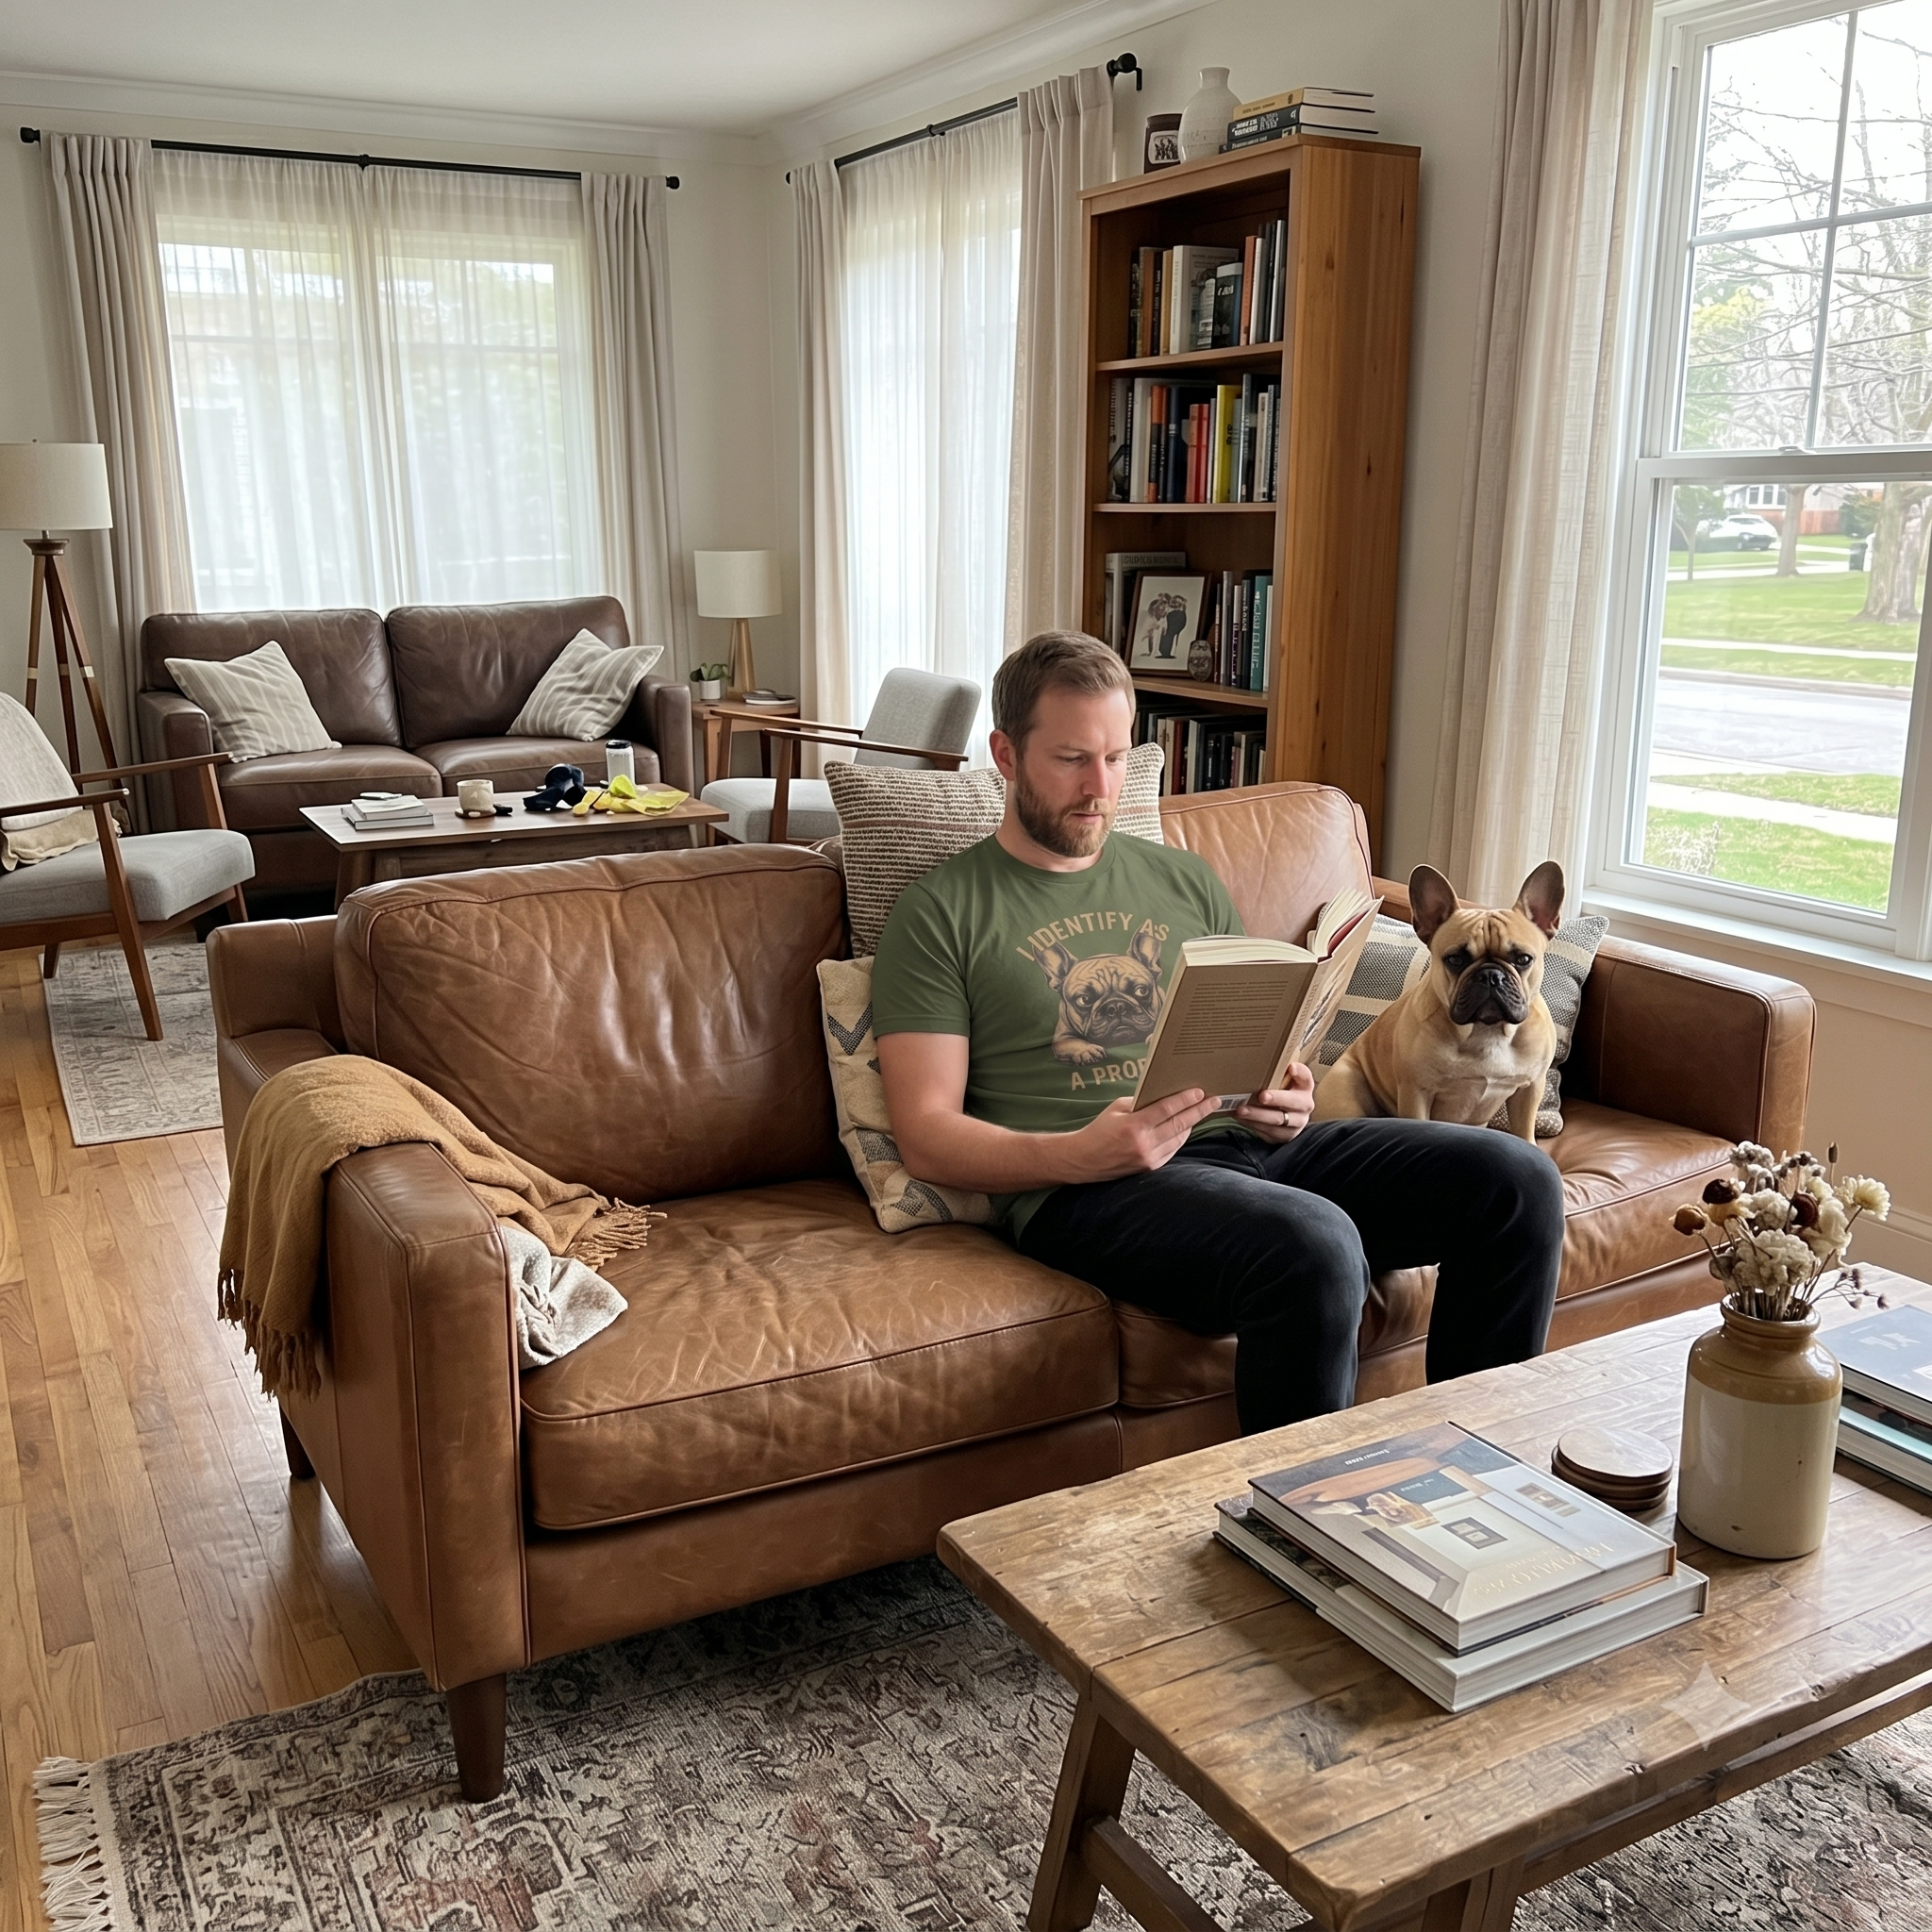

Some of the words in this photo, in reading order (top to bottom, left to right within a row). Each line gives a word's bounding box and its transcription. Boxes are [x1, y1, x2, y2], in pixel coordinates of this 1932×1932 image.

[1016, 946, 1035, 961] I
[1026, 911, 1133, 952] IDENTIFY
[1139, 918, 1169, 941] AS
[1071, 1071, 1086, 1091] A
